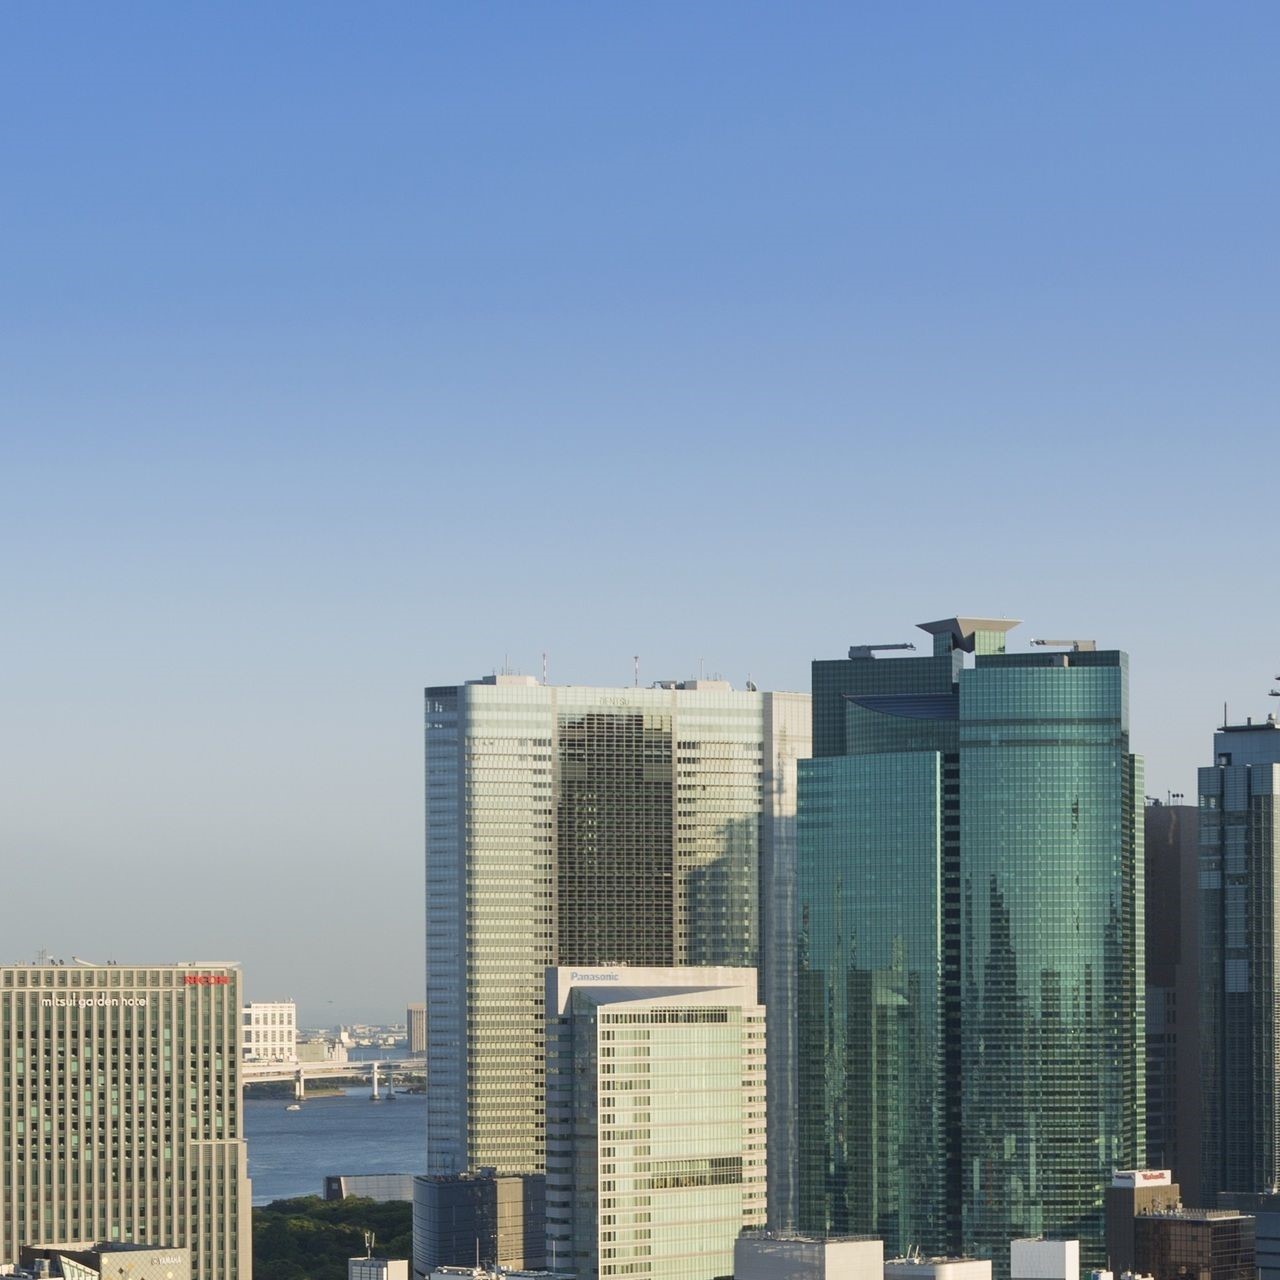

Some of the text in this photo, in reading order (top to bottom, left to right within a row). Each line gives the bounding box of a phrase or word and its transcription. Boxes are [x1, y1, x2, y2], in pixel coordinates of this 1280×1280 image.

[570, 971, 619, 982] Panasonic
[41, 992, 149, 1009] mitsui garden hotel
[159, 1256, 182, 1266] YAMAHA
